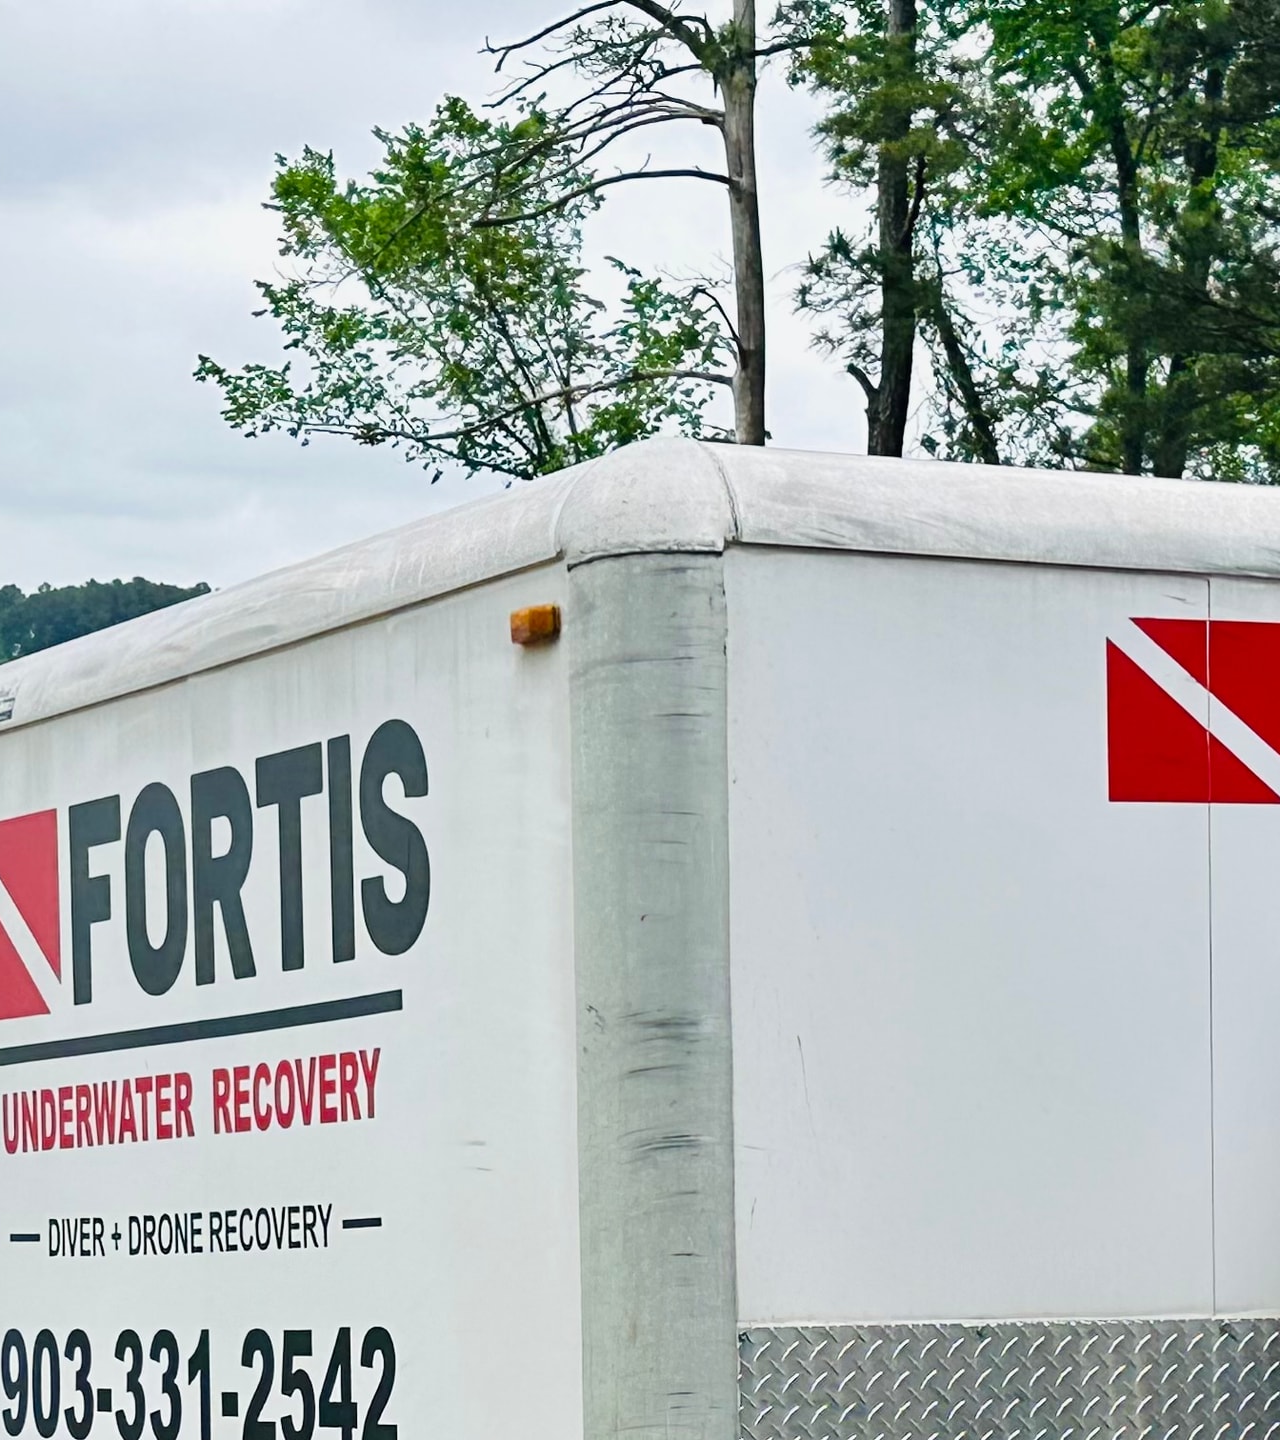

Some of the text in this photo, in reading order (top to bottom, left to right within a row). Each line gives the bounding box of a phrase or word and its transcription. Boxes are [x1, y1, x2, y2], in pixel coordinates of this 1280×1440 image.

[68, 718, 430, 1006] FORTIS
[1, 1047, 382, 1155] UNDERWATER RECOVERY
[48, 1203, 333, 1258] DIVER + DRONE RECOVERY
